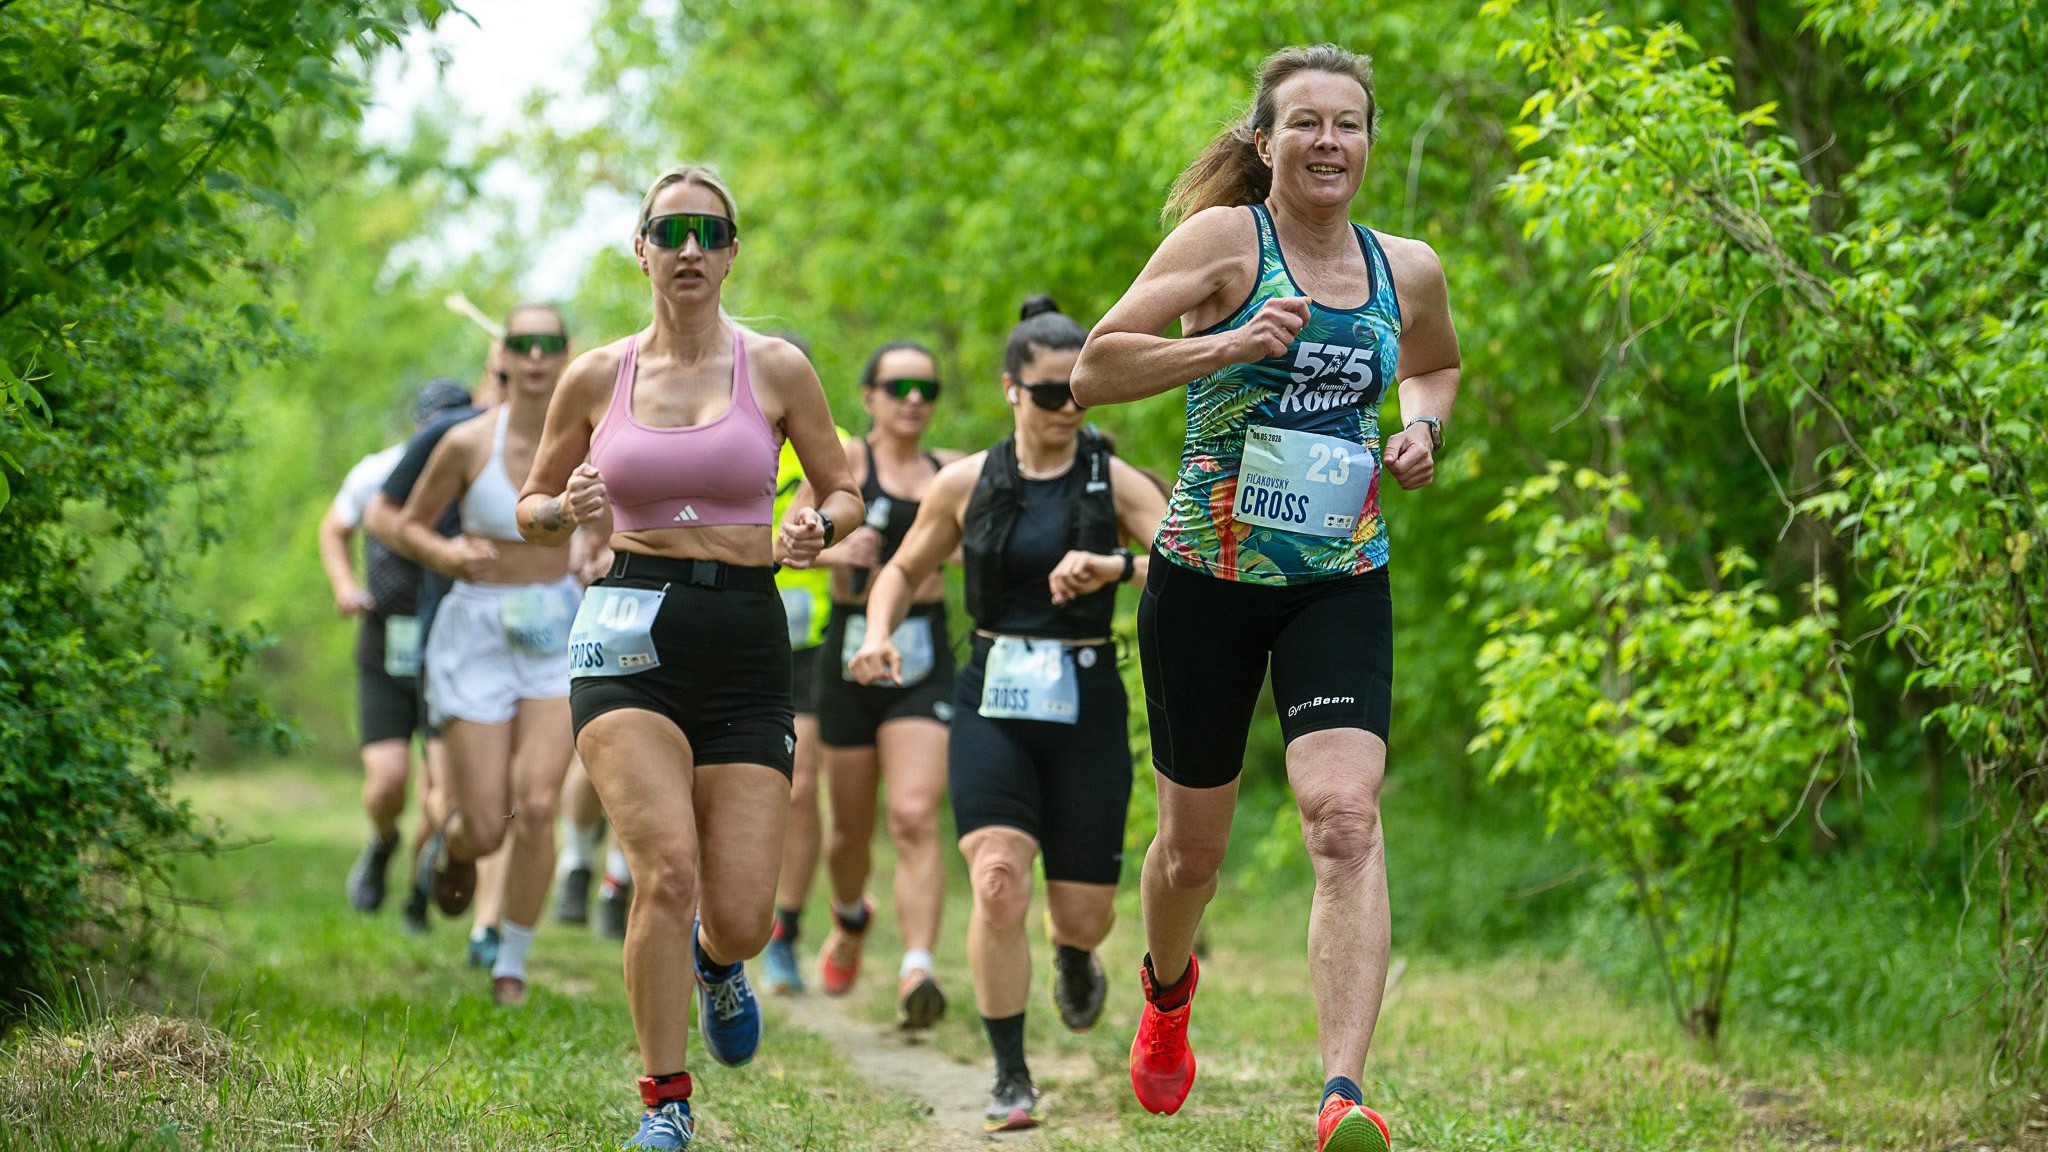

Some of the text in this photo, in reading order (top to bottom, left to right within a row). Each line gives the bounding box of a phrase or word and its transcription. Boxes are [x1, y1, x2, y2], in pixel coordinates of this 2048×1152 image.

[1291, 342, 1374, 391] 575
[1280, 384, 1364, 413] Kona
[1317, 382, 1348, 391] Hawaii
[1306, 443, 1350, 486] 23
[1246, 473, 1289, 490] FIĽAKOVSKÝ
[1240, 485, 1310, 524] CROSS
[597, 594, 639, 632] 40
[569, 642, 604, 669] CROSS
[1288, 696, 1355, 717] GymBeam
